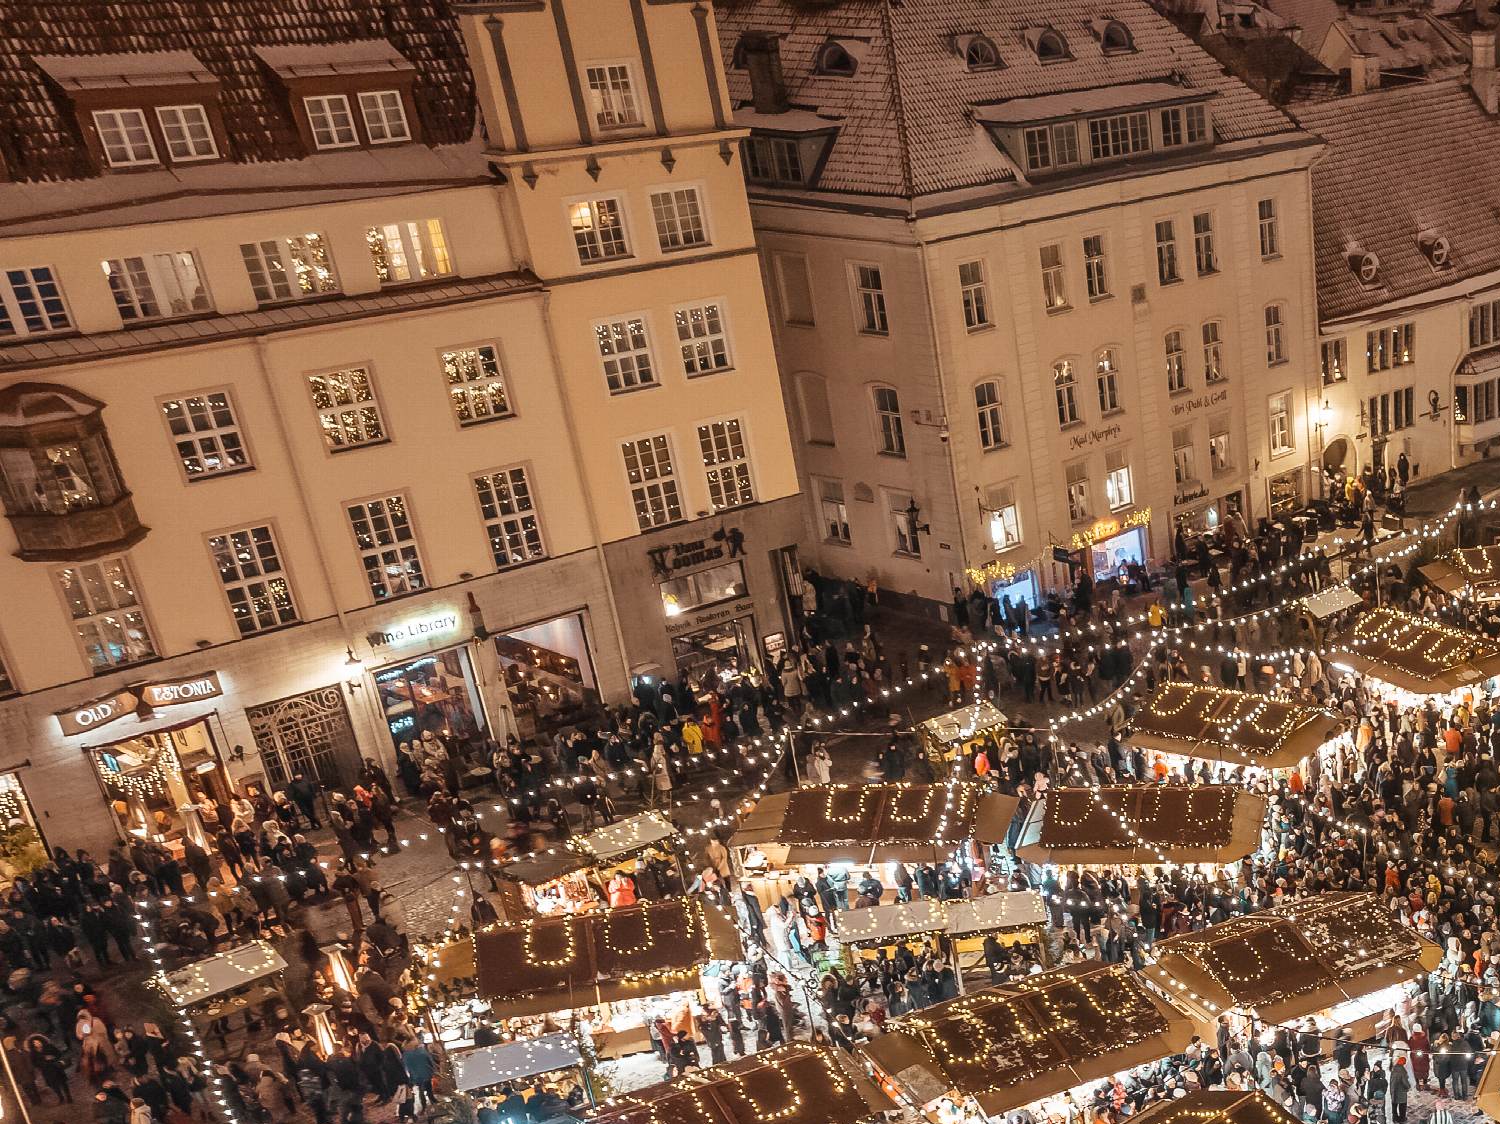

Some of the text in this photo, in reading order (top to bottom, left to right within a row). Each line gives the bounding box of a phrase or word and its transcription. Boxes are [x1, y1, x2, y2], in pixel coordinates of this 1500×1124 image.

[407, 615, 456, 637] Library
[75, 679, 216, 726] OLD ESTONIA
